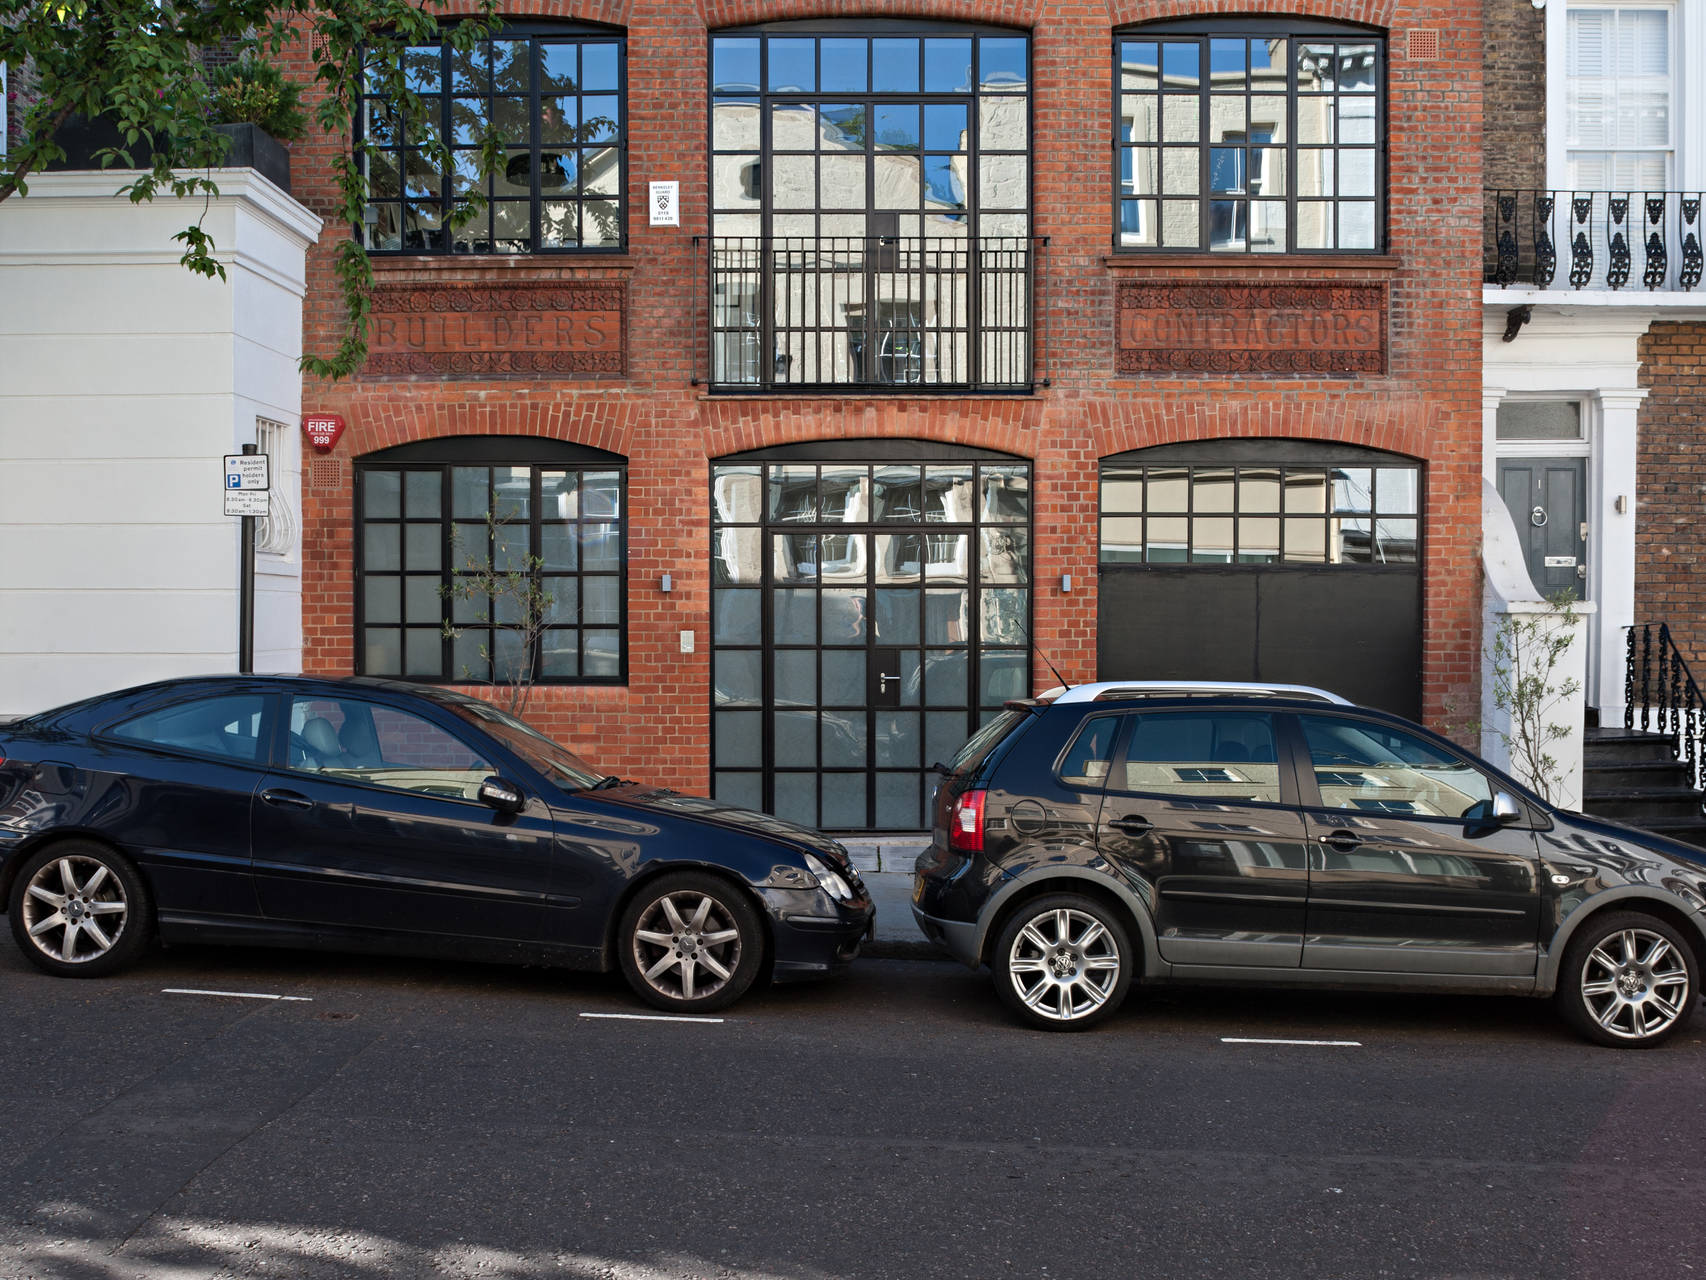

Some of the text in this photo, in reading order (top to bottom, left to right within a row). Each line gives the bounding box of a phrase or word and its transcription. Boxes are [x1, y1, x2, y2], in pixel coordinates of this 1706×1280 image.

[376, 315, 607, 349] BUILDERS
[1129, 308, 1374, 347] CONTRACTORS
[307, 421, 337, 432] FIRE
[313, 436, 330, 444] 999
[229, 475, 239, 487] P
